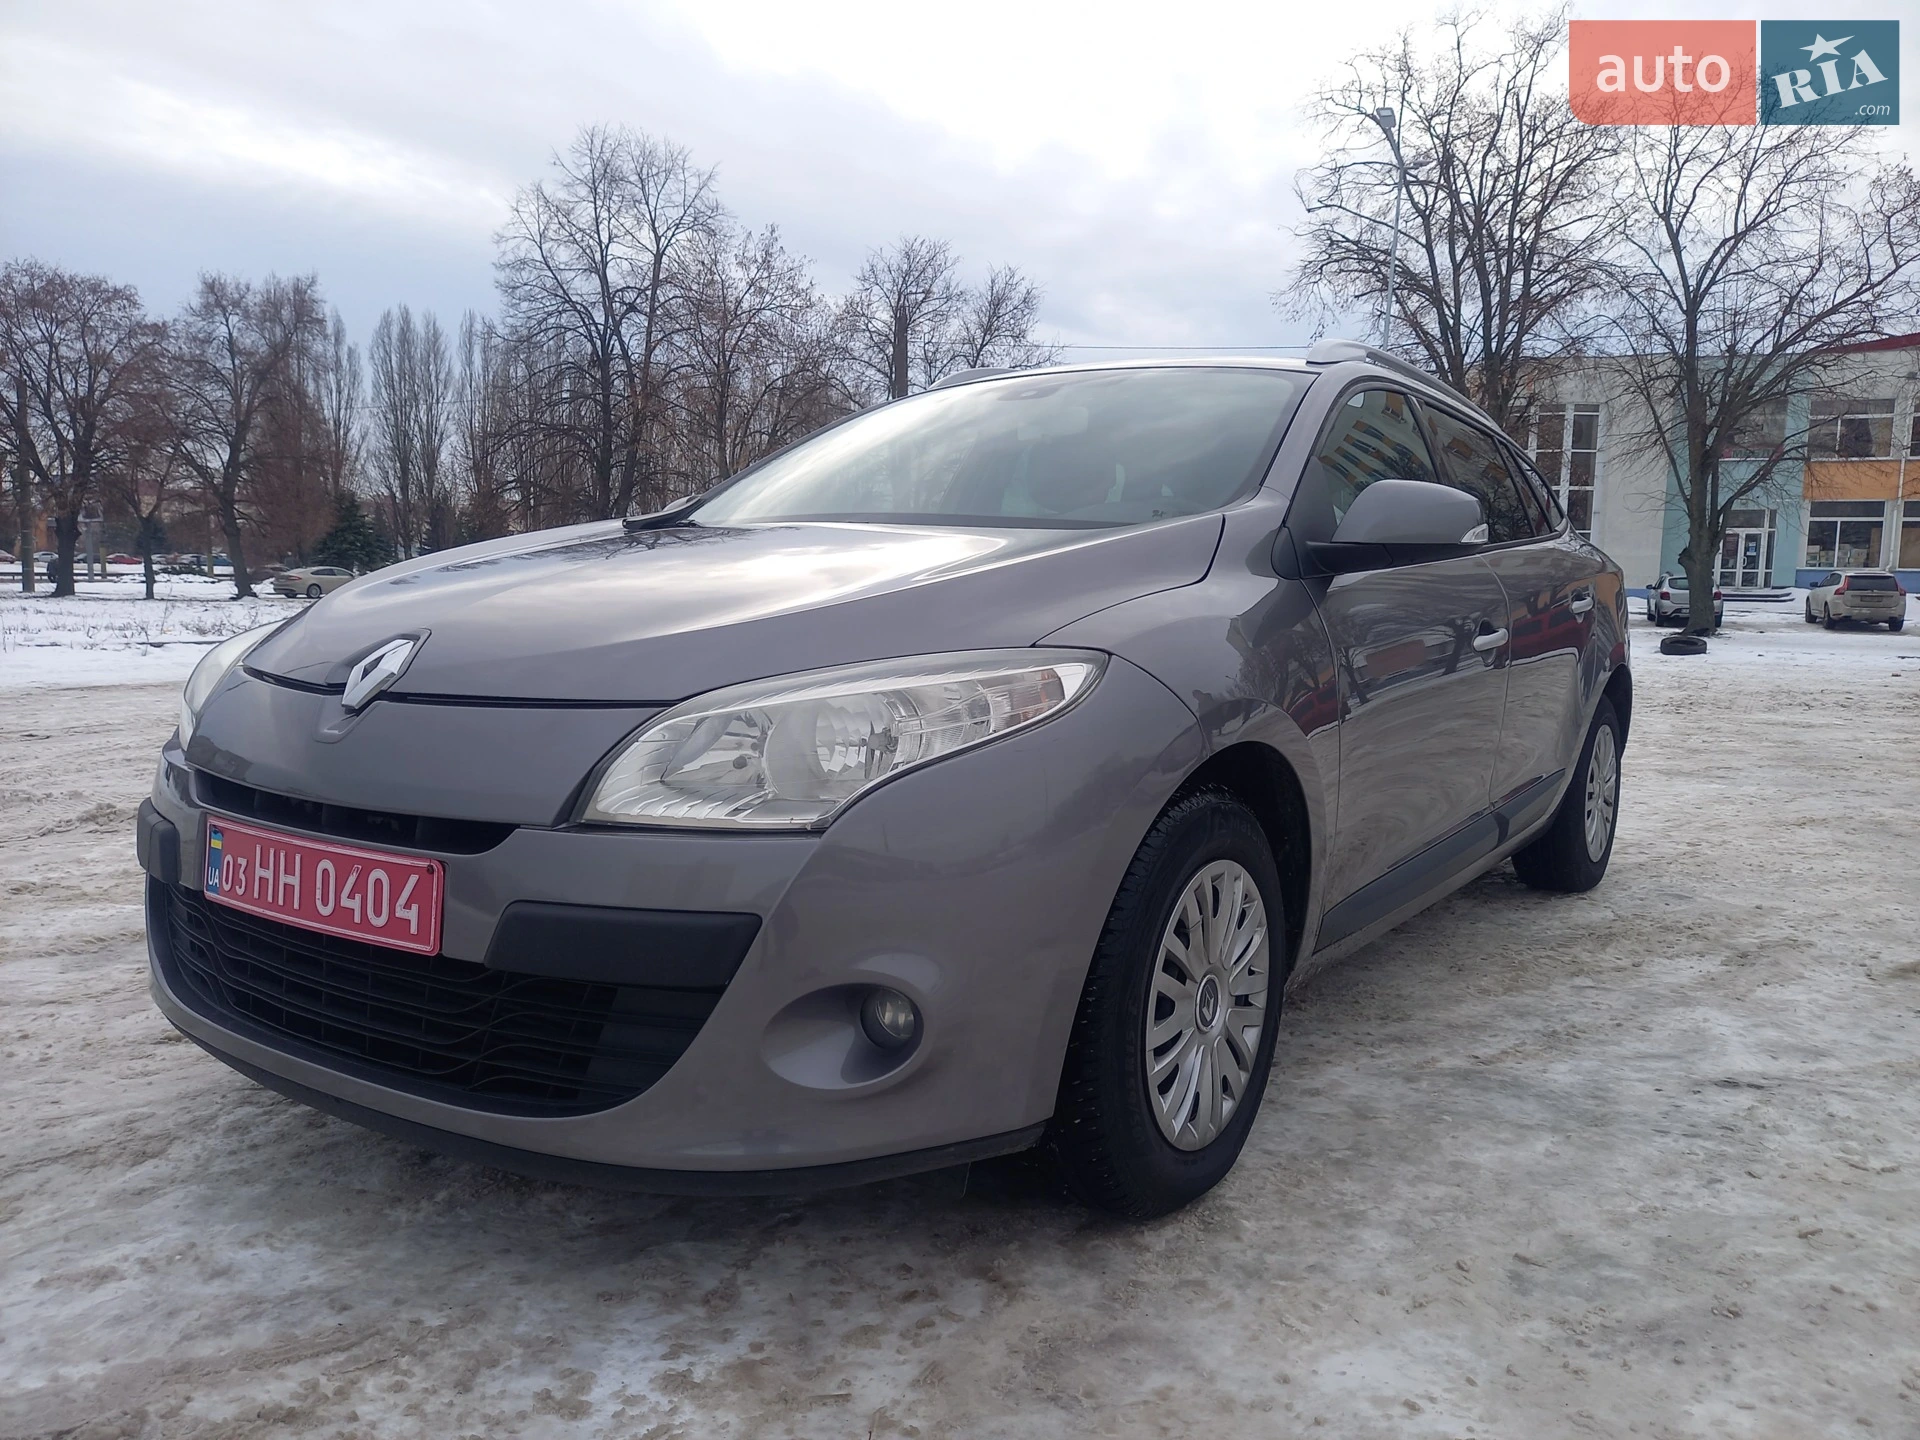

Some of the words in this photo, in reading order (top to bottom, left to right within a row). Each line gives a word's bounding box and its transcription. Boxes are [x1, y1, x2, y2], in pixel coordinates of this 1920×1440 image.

[208, 866, 220, 888] UA
[222, 854, 248, 896] 03
[253, 844, 302, 910] HH
[315, 859, 420, 935] 0404
